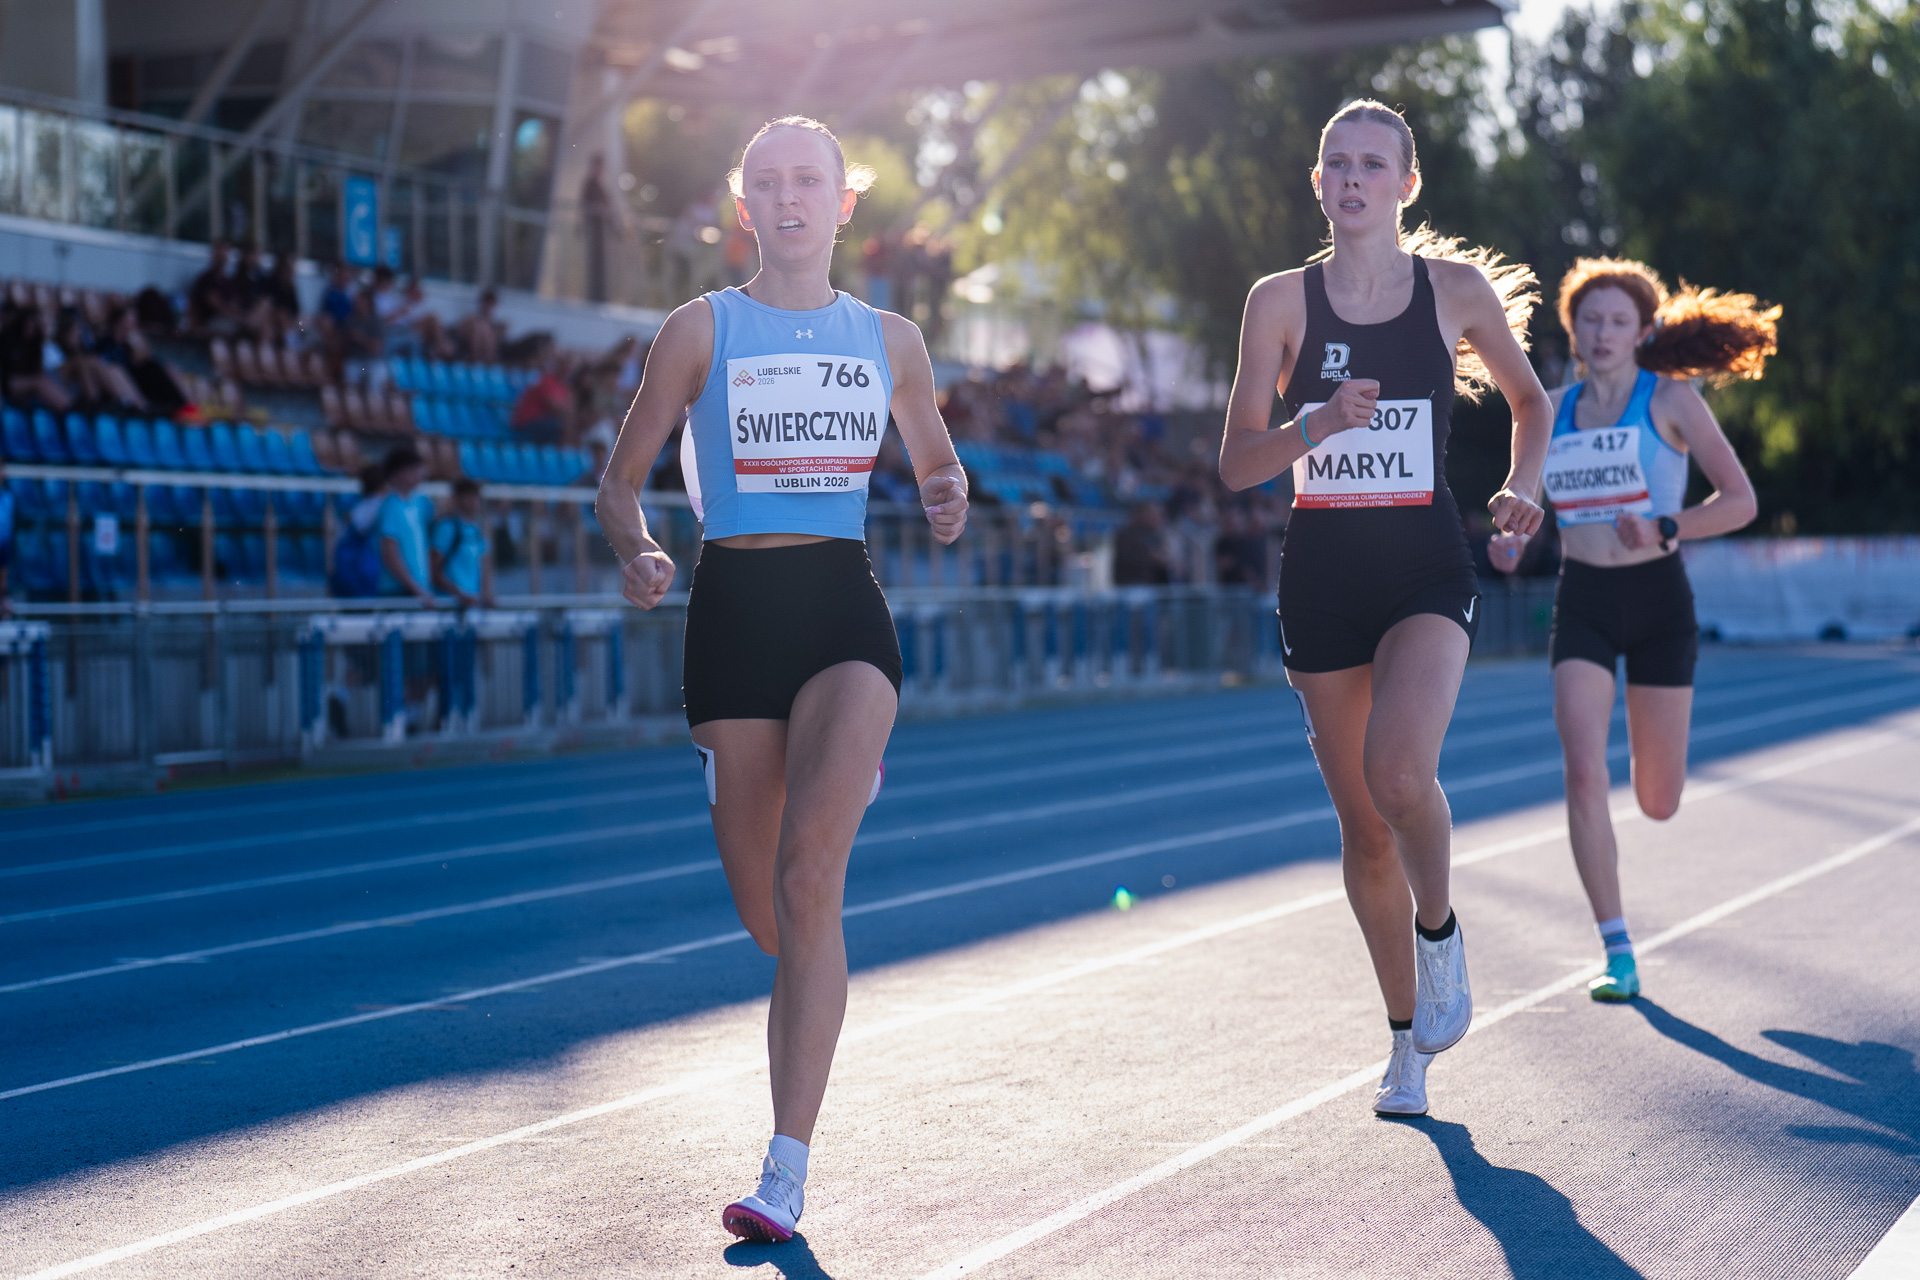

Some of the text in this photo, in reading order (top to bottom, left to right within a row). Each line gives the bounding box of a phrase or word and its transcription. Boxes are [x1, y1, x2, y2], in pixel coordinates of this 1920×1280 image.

[757, 366, 802, 376] LUBELSKIE
[817, 362, 870, 388] 766
[1320, 370, 1351, 379] DUCLA
[758, 377, 775, 386] 2026
[1368, 407, 1418, 431] 307
[736, 408, 877, 444] ŚWIERCZYNA
[1592, 431, 1629, 452] 417
[760, 458, 814, 467] OGÓLNOPOLSKA
[815, 457, 848, 465] OLIMPIADA
[1307, 452, 1413, 480] MARYL
[774, 476, 850, 488] LUBLIN 2026
[1314, 493, 1360, 502] OGÓLNOPOLSKA
[1360, 493, 1393, 501] OLIMPIADA
[1393, 490, 1427, 499] MŁODZIEŻY
[1336, 500, 1368, 508] SPORTACH
